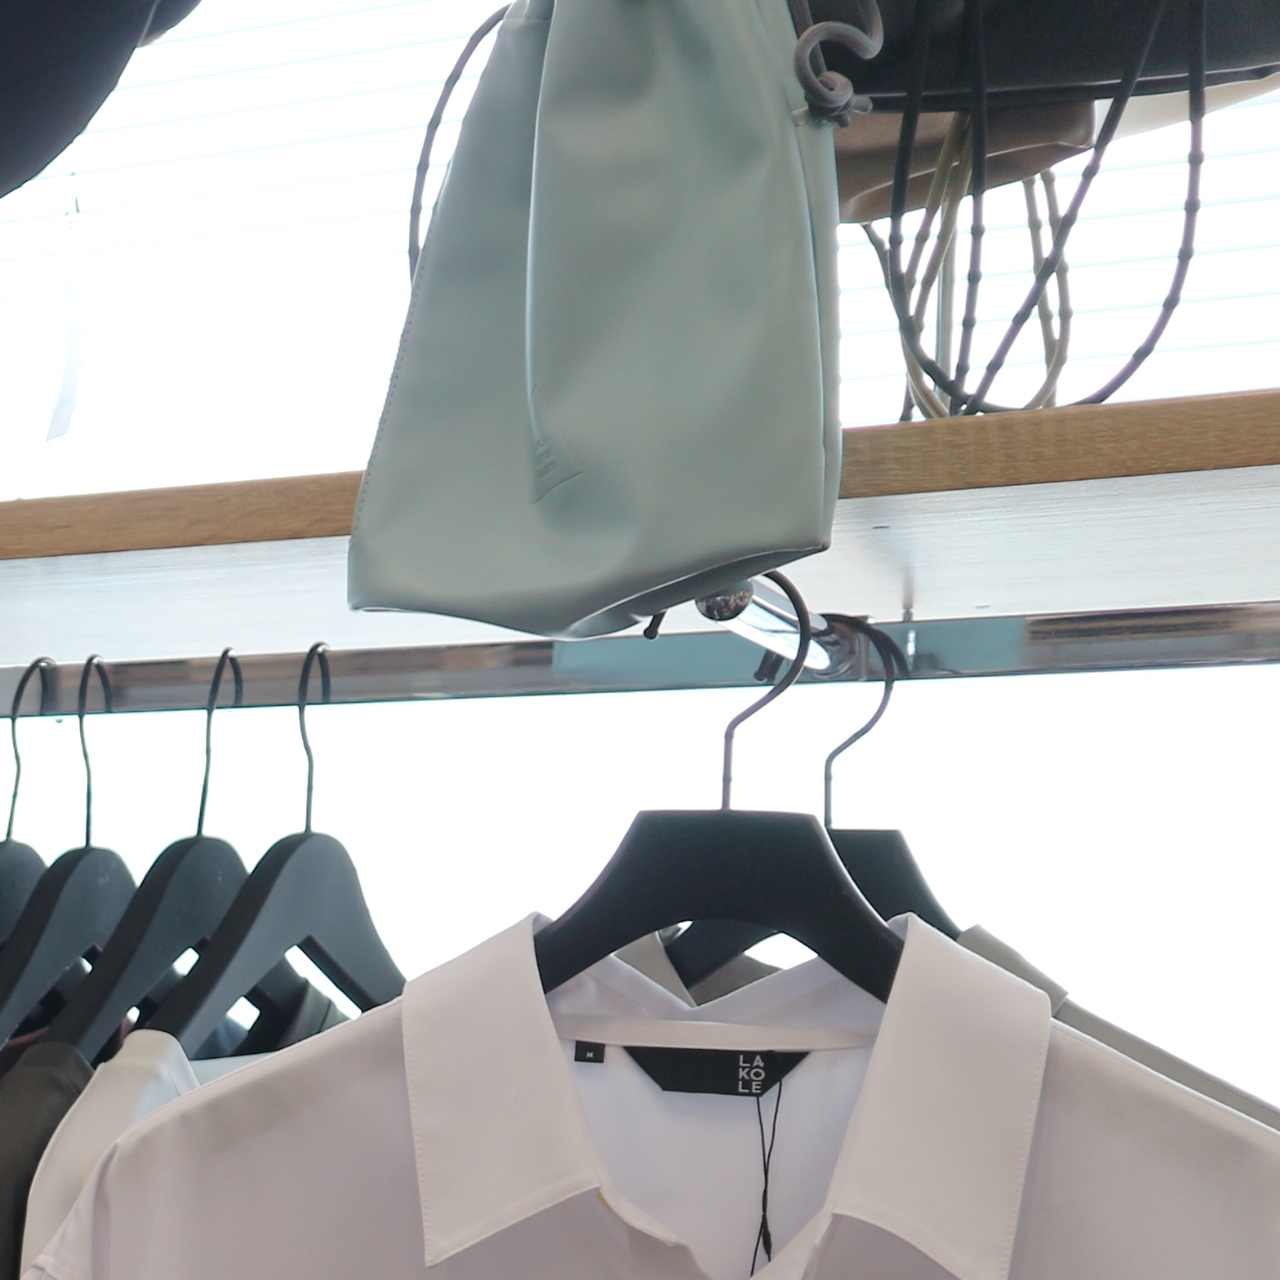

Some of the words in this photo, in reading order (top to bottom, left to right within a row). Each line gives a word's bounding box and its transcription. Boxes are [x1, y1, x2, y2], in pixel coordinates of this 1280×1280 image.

[739, 1054, 765, 1067] LA
[738, 1067, 766, 1081] KO
[738, 1081, 762, 1093] LE
